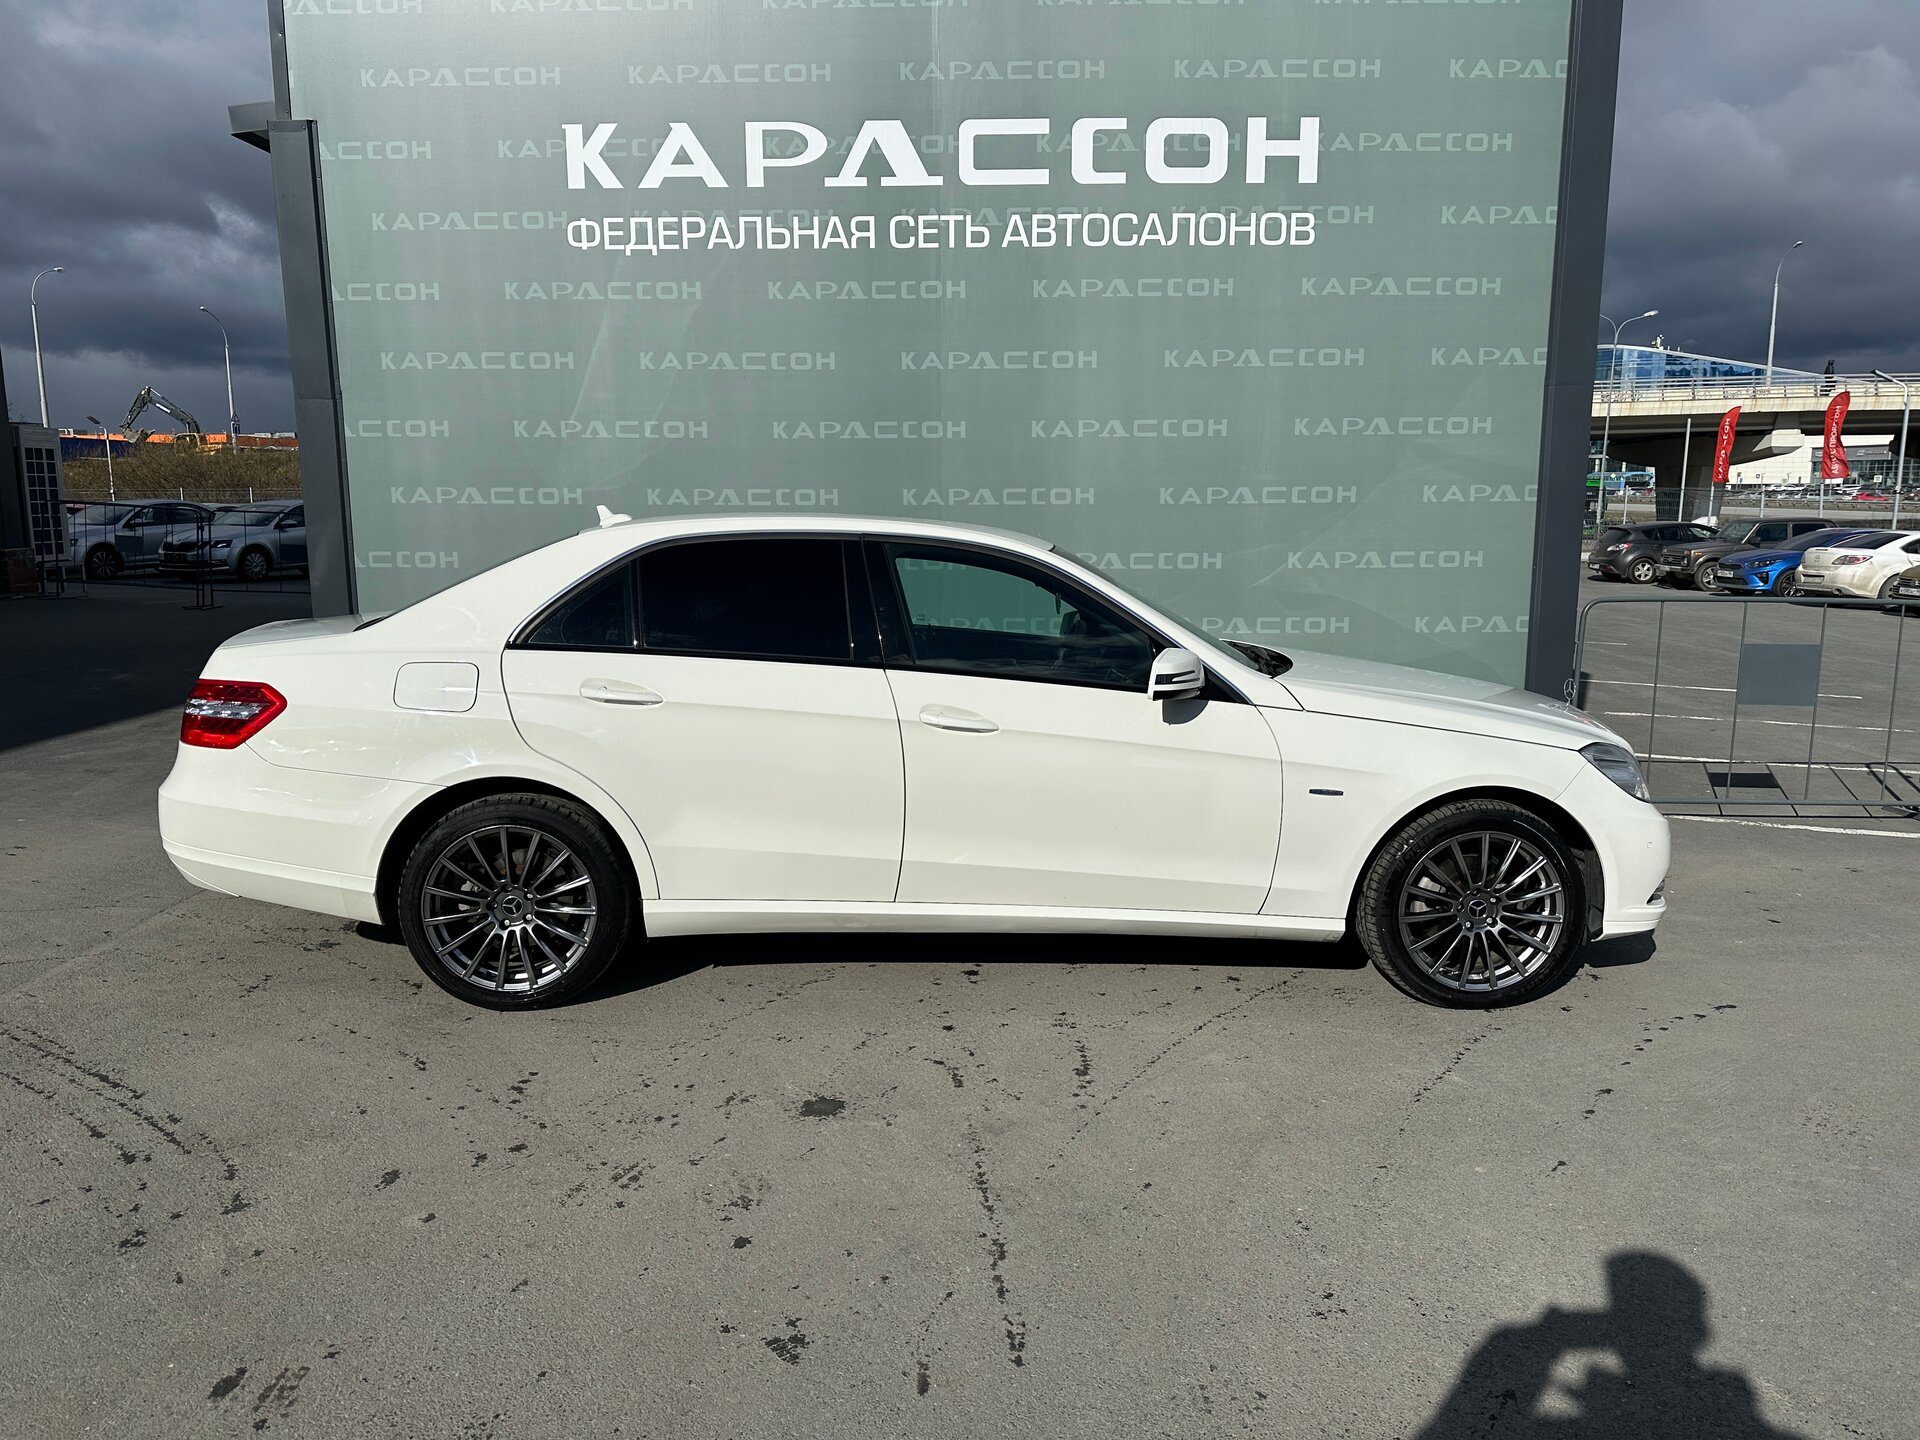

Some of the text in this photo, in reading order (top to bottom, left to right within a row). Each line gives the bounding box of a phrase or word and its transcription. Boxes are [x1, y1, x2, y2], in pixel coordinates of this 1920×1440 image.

[562, 117, 1320, 190] КАРАССОН
[568, 213, 1314, 255] ФЕДЕРАЛЬНАЯ СЕТЬ АВТОСАЛОНОВ
